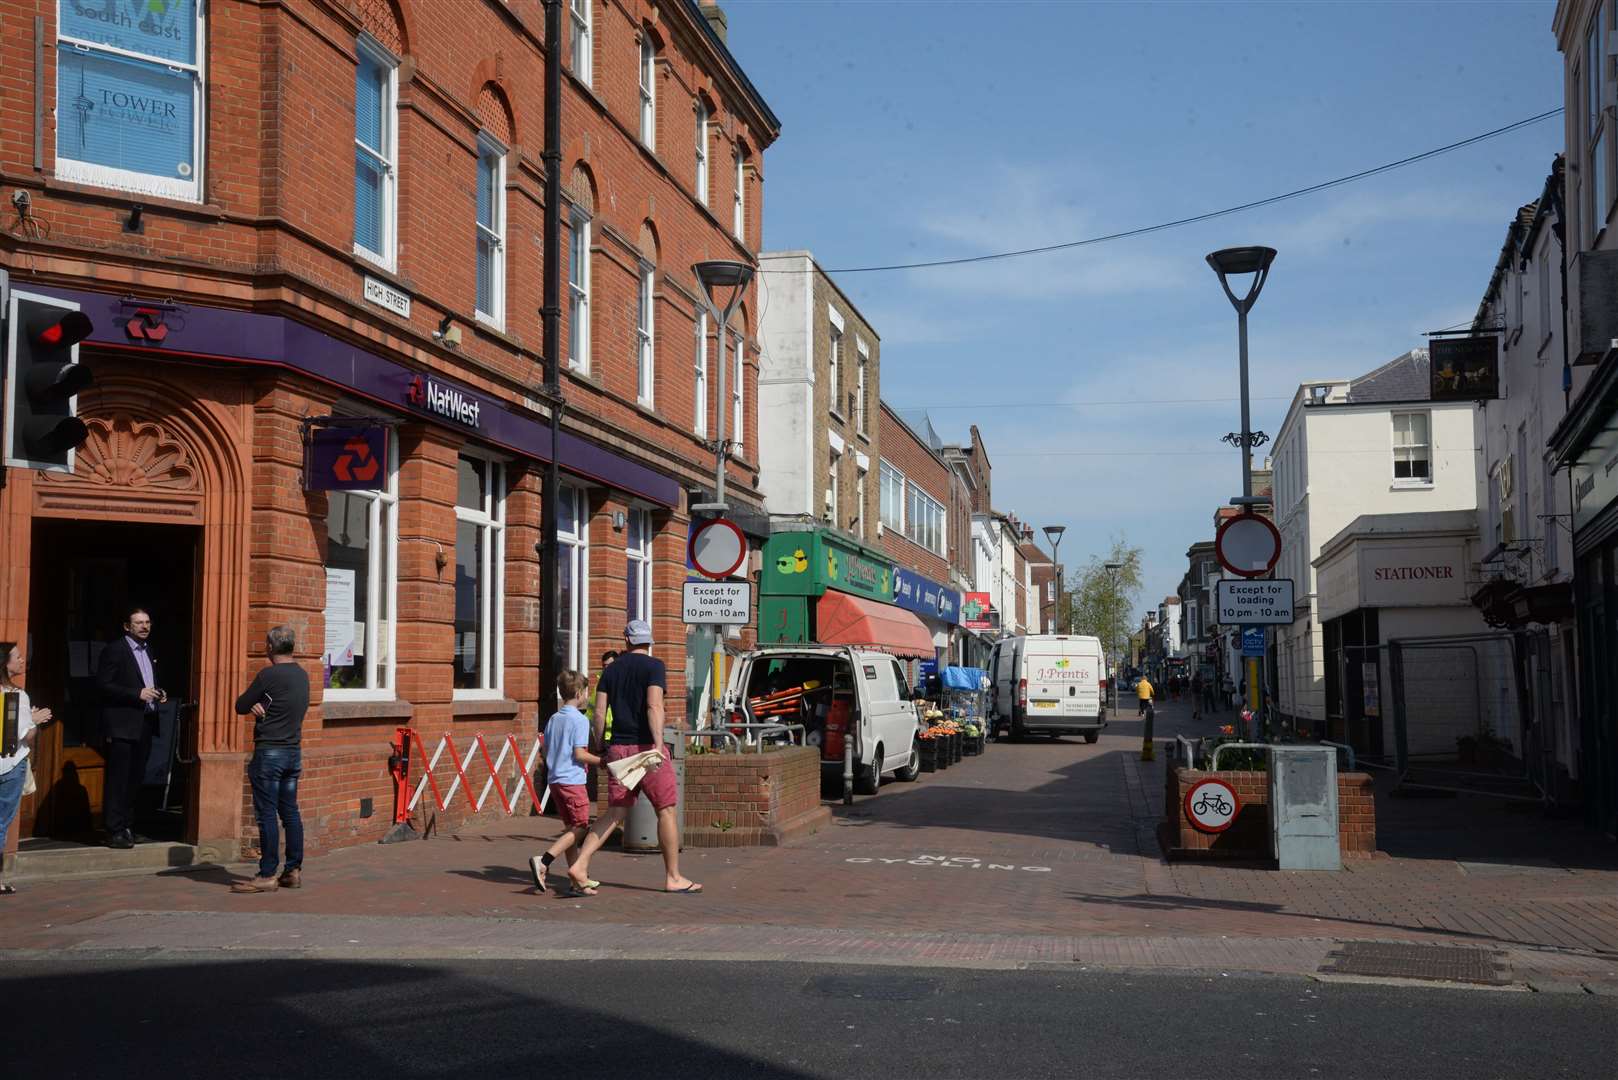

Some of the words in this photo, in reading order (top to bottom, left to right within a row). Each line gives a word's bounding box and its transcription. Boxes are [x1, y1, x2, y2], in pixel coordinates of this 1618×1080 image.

[75, 5, 131, 29] south
[138, 18, 181, 41] east
[98, 88, 176, 119] TOWER
[367, 281, 383, 299] HIGH
[386, 290, 408, 312] STREET
[427, 381, 480, 428] NatWest
[1374, 566, 1454, 581] STATIONER
[693, 587, 724, 596] Except
[727, 587, 740, 595] for
[1229, 585, 1264, 595] Except
[1268, 585, 1283, 594] for
[700, 597, 733, 606] loading
[1237, 596, 1274, 605] loading
[687, 609, 697, 617] 10
[699, 610, 713, 618] pm
[720, 609, 730, 617] 10
[1223, 608, 1235, 617] 10
[1237, 610, 1253, 618] pm
[1260, 608, 1272, 617] 10
[918, 855, 981, 863] NO
[845, 858, 1052, 872] CYCLING
